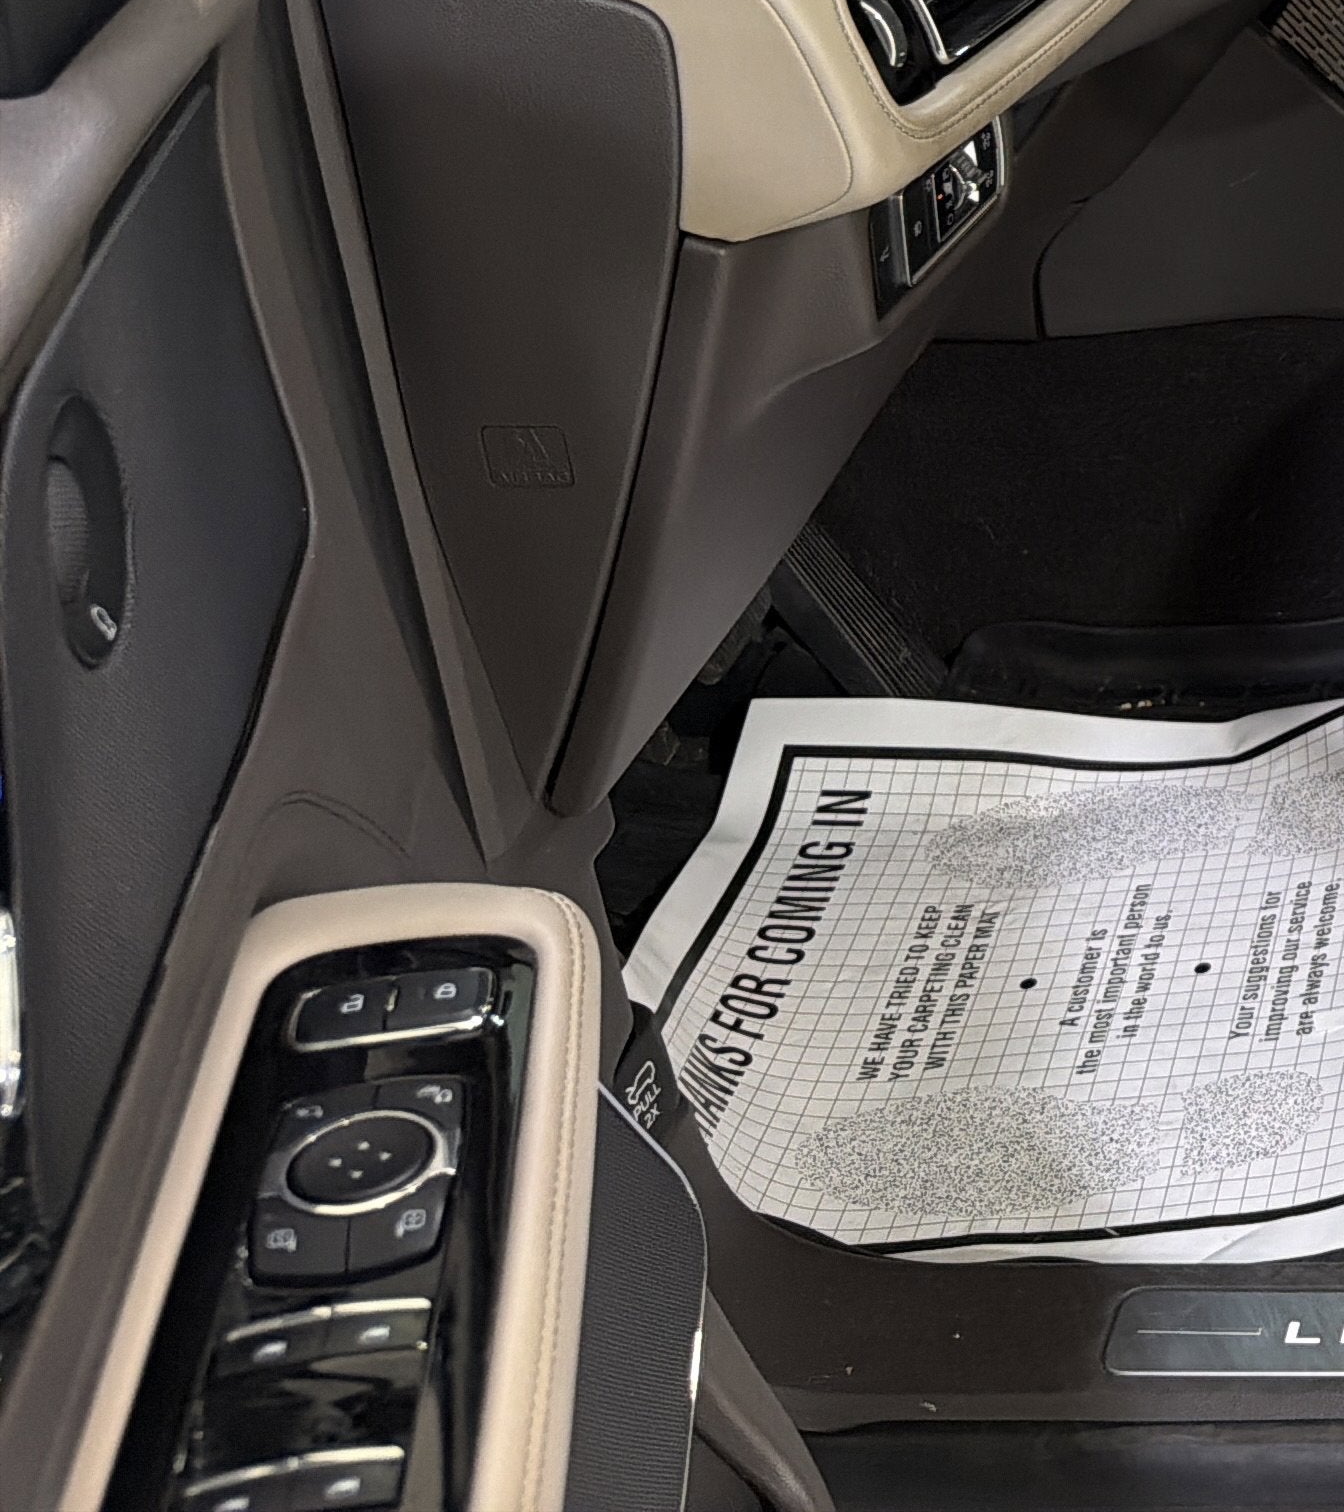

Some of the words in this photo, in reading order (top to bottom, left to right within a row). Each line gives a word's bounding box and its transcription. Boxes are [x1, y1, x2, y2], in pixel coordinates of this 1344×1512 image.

[812, 790, 872, 827] IN
[747, 841, 855, 965] COMING
[913, 905, 944, 939] KEEP
[1124, 883, 1151, 930] person
[1288, 880, 1313, 934] service
[1313, 877, 1342, 950] welcome.
[904, 943, 930, 963] TO
[1085, 928, 1108, 941] is
[1144, 933, 1165, 949] to
[1282, 937, 1300, 961] our
[954, 943, 989, 990] PAPER
[1067, 944, 1102, 1013] customer
[1099, 932, 1136, 1003] important
[1135, 951, 1160, 995] world
[1228, 1005, 1256, 1041] Your
[1242, 914, 1277, 1001] suggestions
[1260, 891, 1282, 911] for
[1300, 952, 1330, 1006] always
[710, 973, 792, 1040] FOR
[885, 966, 920, 1009] TRIED
[888, 1038, 924, 1082] YOUR
[907, 952, 956, 1033] CARPETING
[940, 904, 975, 949] CLEAN
[1258, 964, 1299, 1043] improving
[939, 993, 970, 1028] THIS
[1059, 1016, 1079, 1027] A
[1088, 1003, 1114, 1044] most
[1123, 996, 1148, 1021] the
[1296, 1009, 1314, 1036] are
[868, 1012, 902, 1052] HAVE
[923, 1030, 957, 1071] WITH
[1116, 1023, 1140, 1039] in
[856, 1056, 885, 1081] WE
[1075, 1049, 1101, 1076] the
[633, 1083, 661, 1122] PULL
[644, 1103, 660, 1129] 2X
